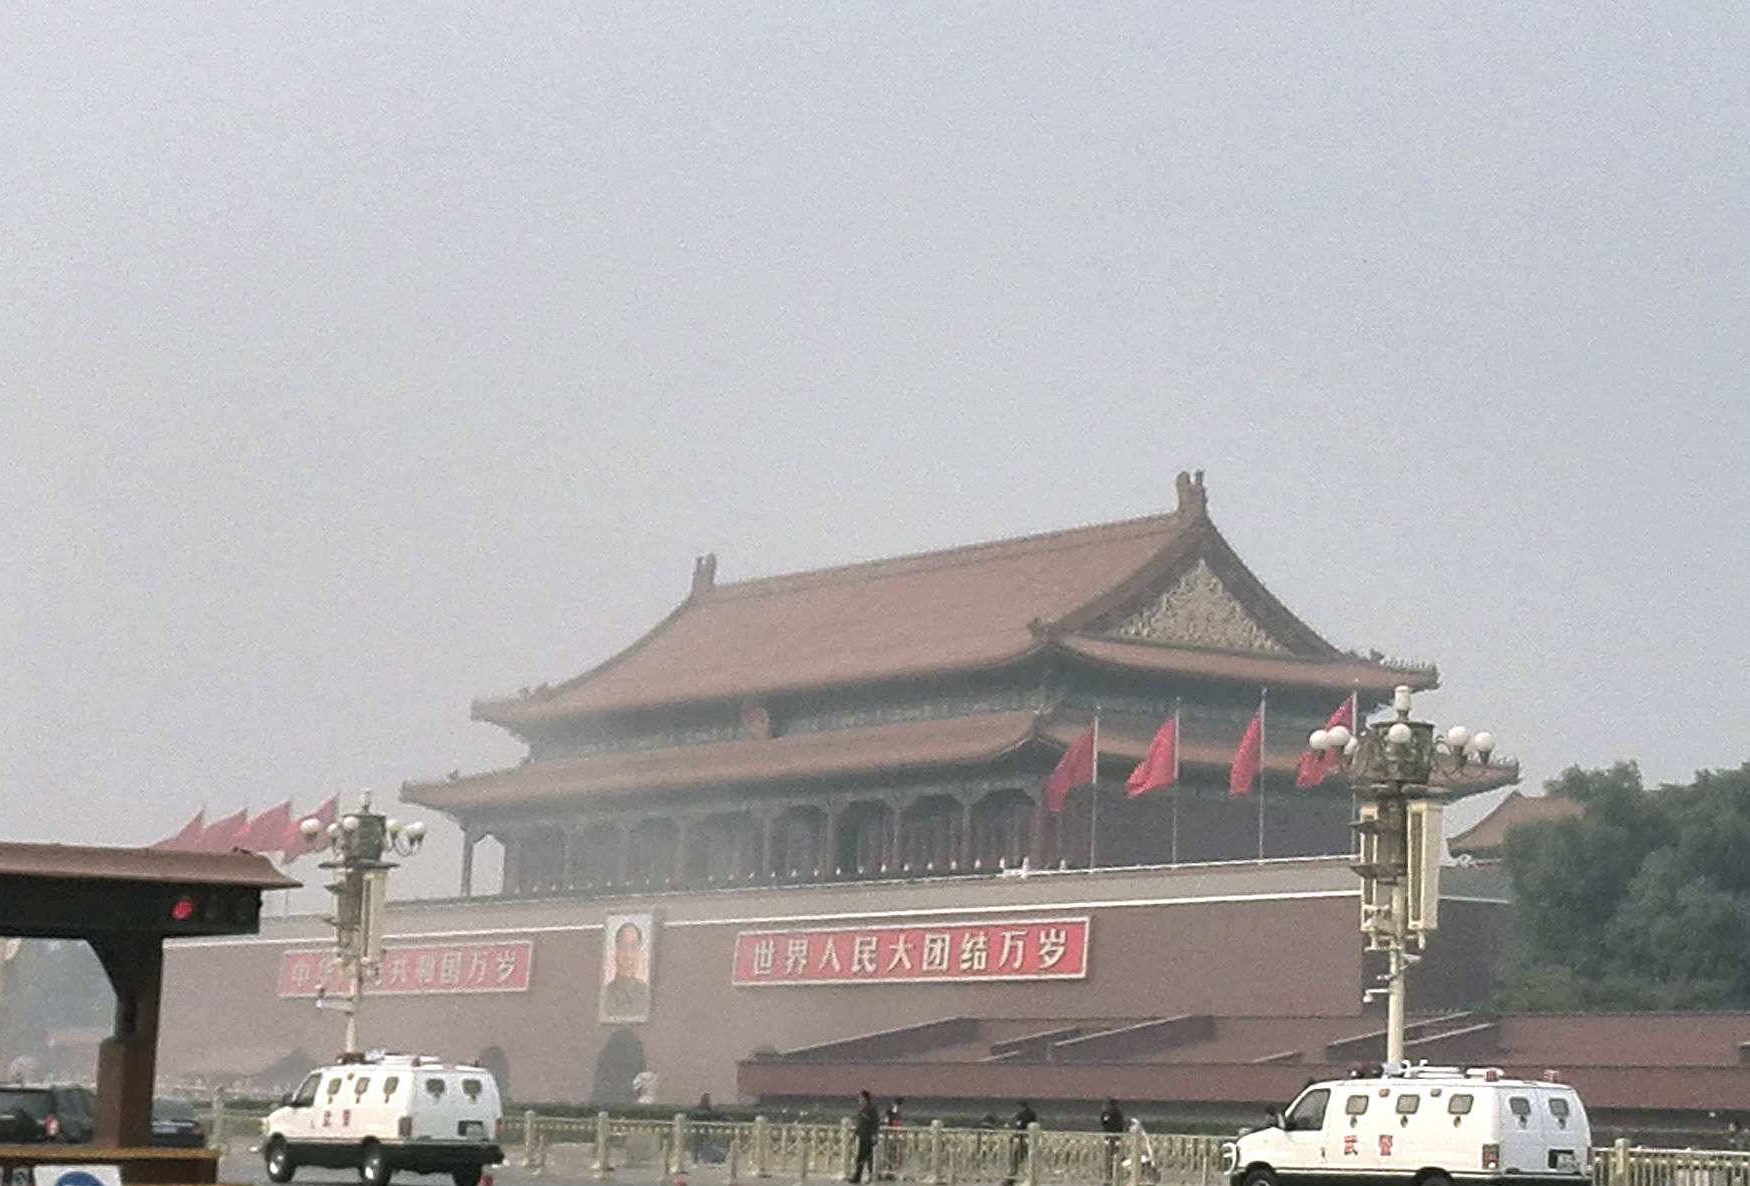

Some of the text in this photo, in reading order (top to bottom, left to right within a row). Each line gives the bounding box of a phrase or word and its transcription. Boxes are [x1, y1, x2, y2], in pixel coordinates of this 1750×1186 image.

[292, 948, 517, 988] 中华共和国万岁
[753, 928, 1067, 976] 世界人民大团结万岁
